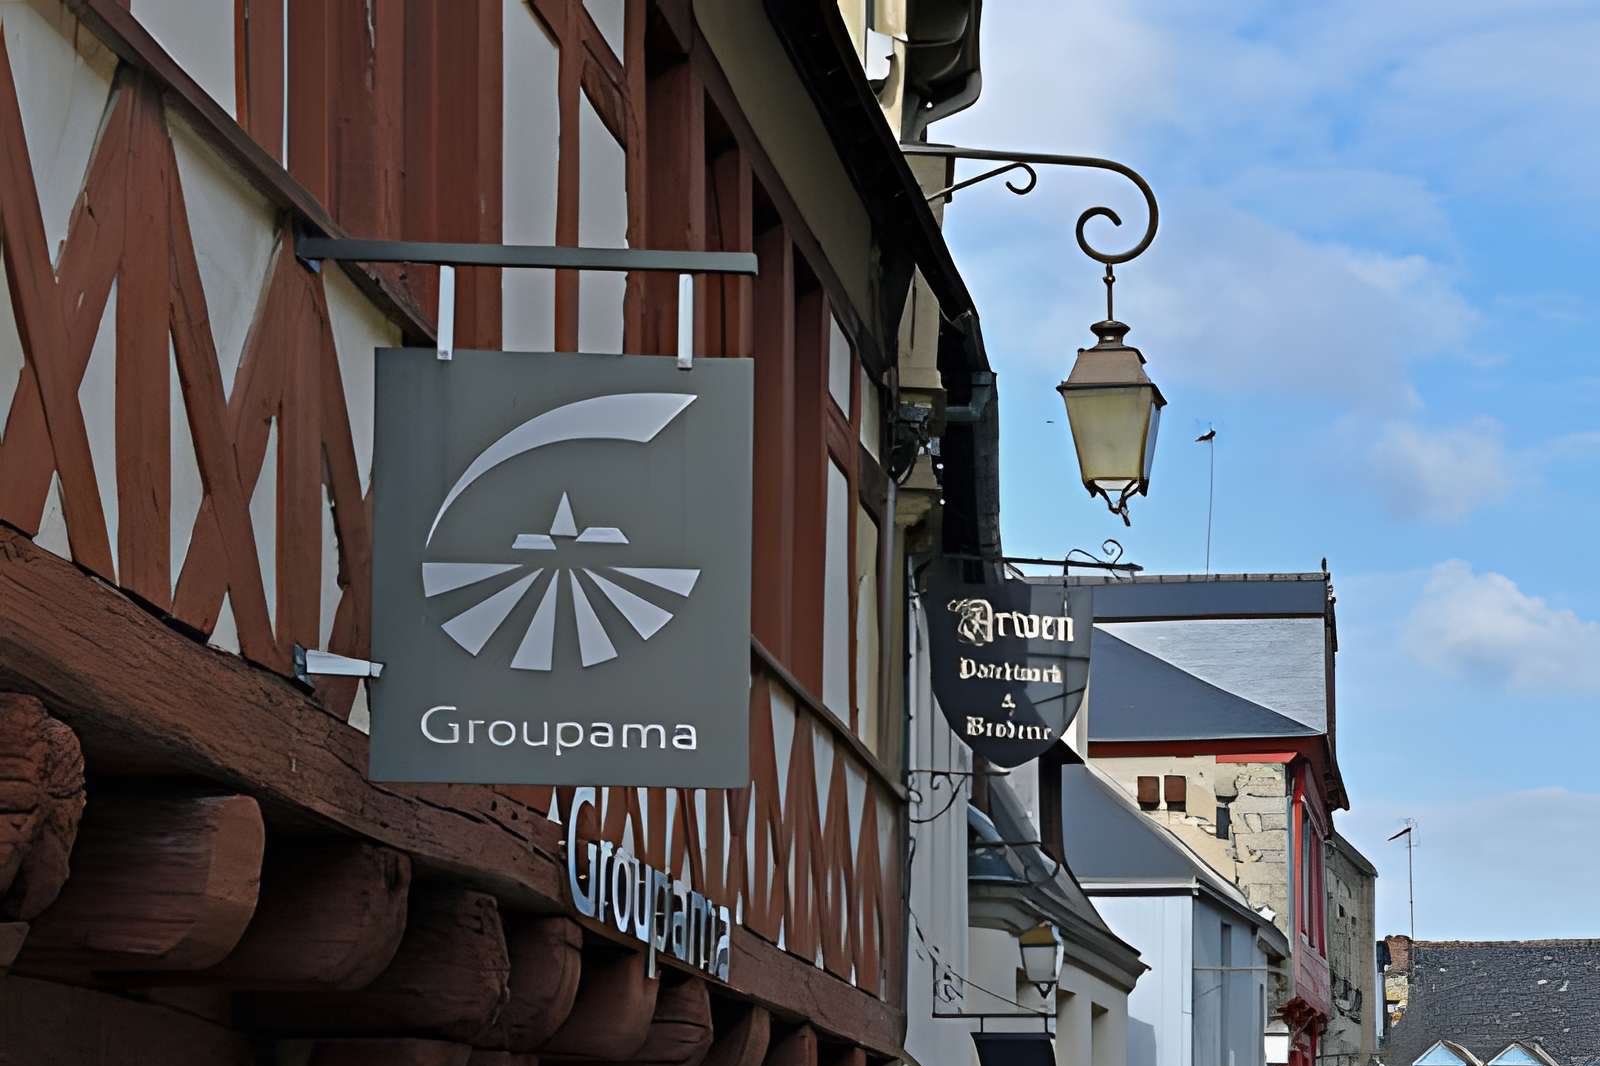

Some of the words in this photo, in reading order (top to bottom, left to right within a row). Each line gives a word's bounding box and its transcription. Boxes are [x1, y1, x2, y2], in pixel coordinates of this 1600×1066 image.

[947, 599, 1075, 646] Arwen
[420, 705, 698, 756] Groupama
[567, 787, 731, 979] Groupama
